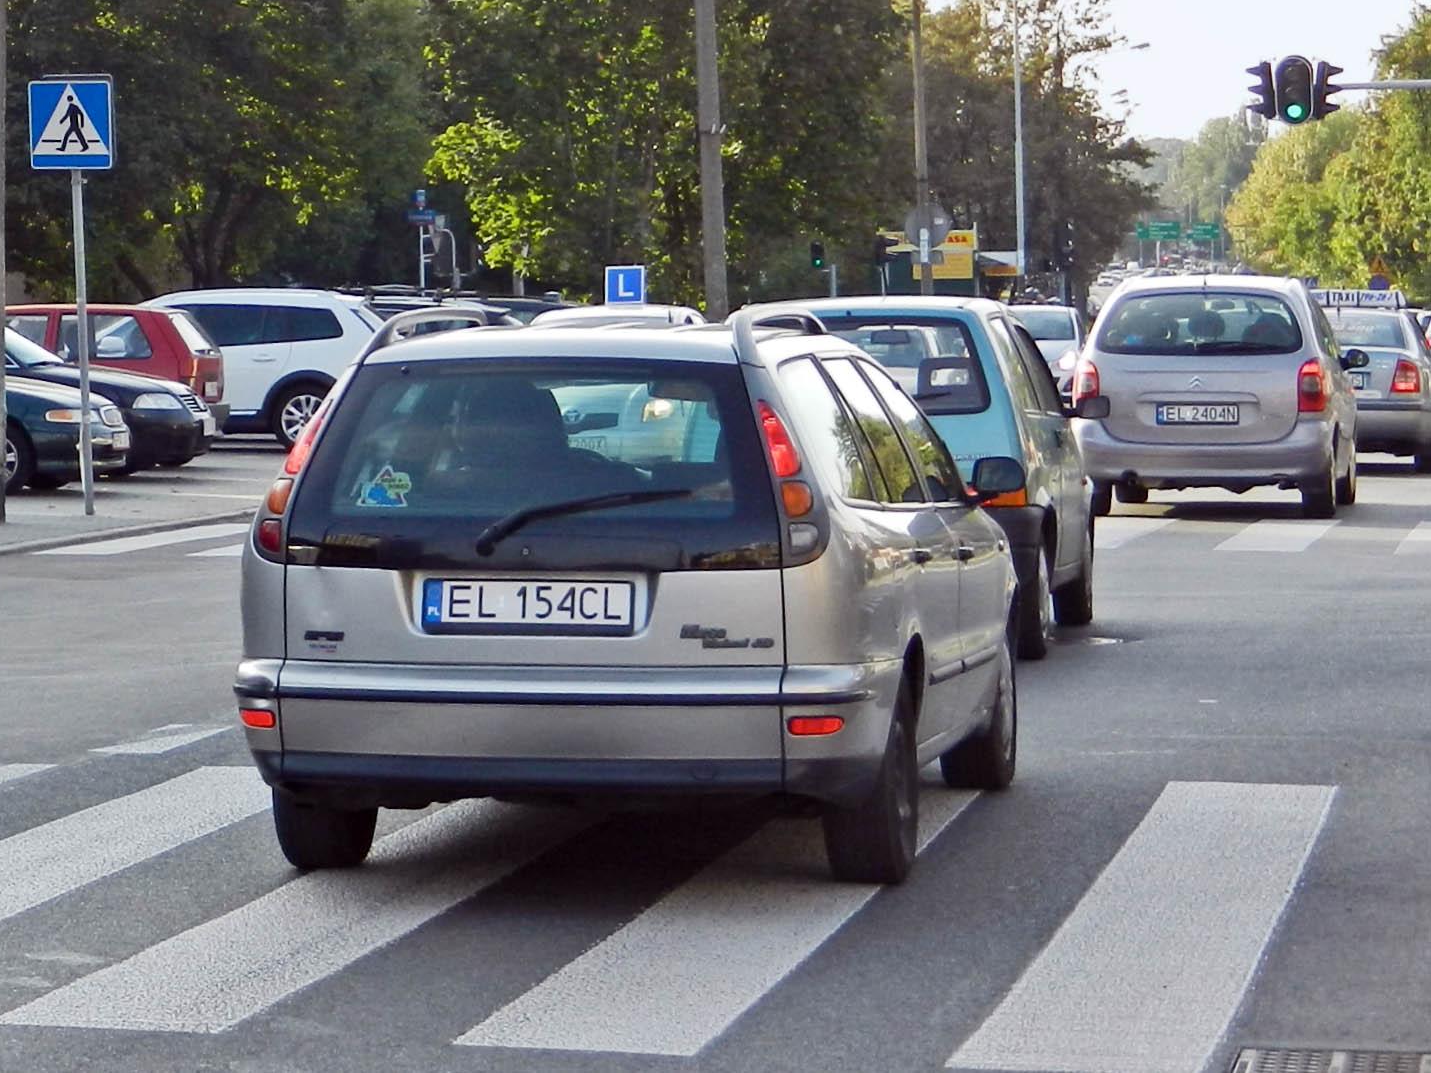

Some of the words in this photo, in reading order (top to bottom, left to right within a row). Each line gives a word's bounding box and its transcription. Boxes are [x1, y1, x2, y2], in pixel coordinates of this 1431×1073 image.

[618, 273, 635, 297] L
[1332, 292, 1355, 302] TAXI
[1167, 407, 1185, 420] EL
[1192, 407, 1236, 420] 2404N
[427, 606, 440, 616] PL
[449, 585, 496, 618] EL
[516, 586, 622, 620] 154CL
